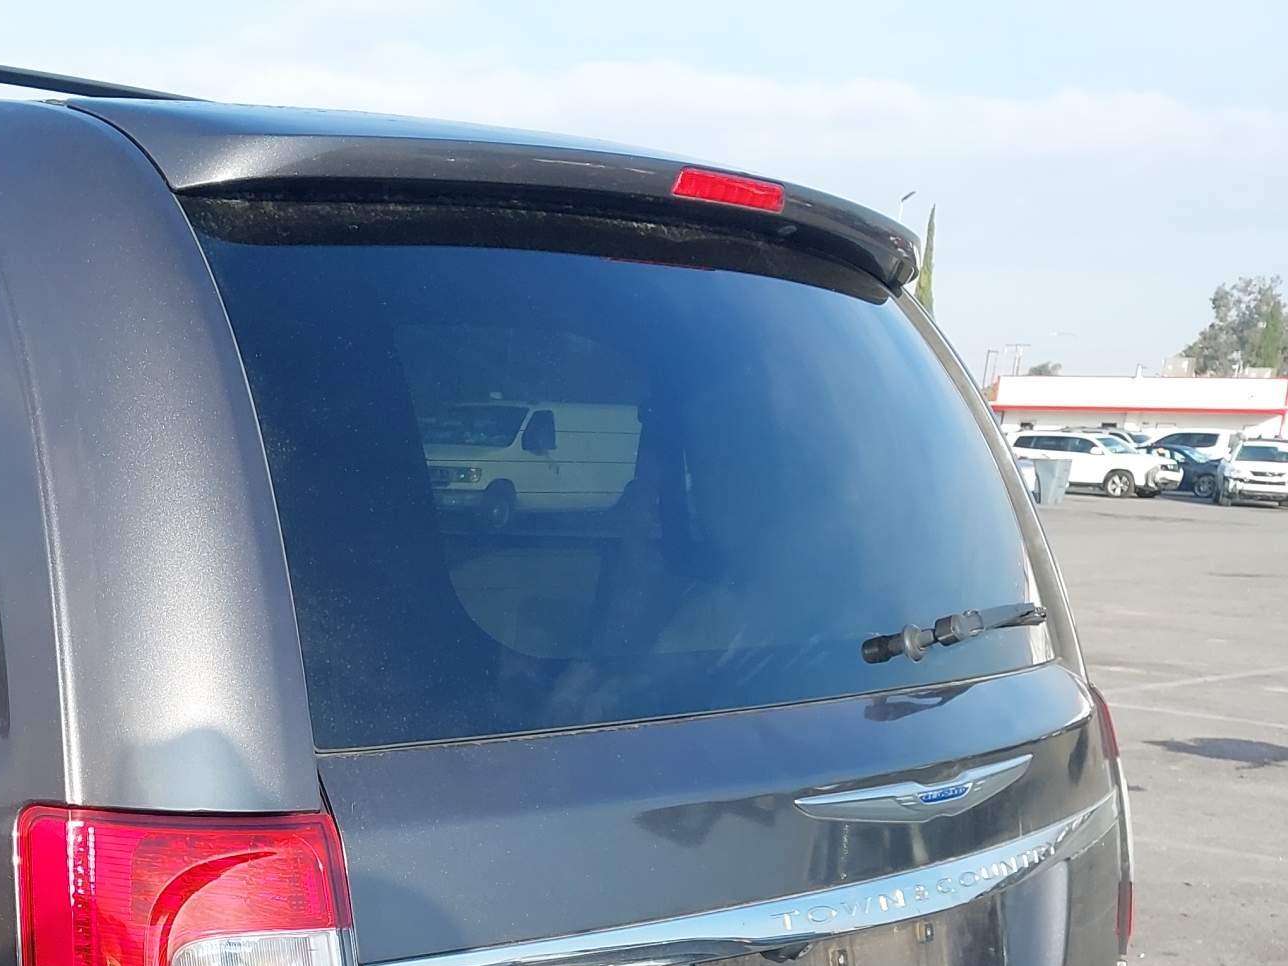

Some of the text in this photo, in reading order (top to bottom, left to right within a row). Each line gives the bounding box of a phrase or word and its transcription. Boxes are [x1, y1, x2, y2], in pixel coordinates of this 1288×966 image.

[770, 842, 1057, 931] TOWN & COUNTRY
